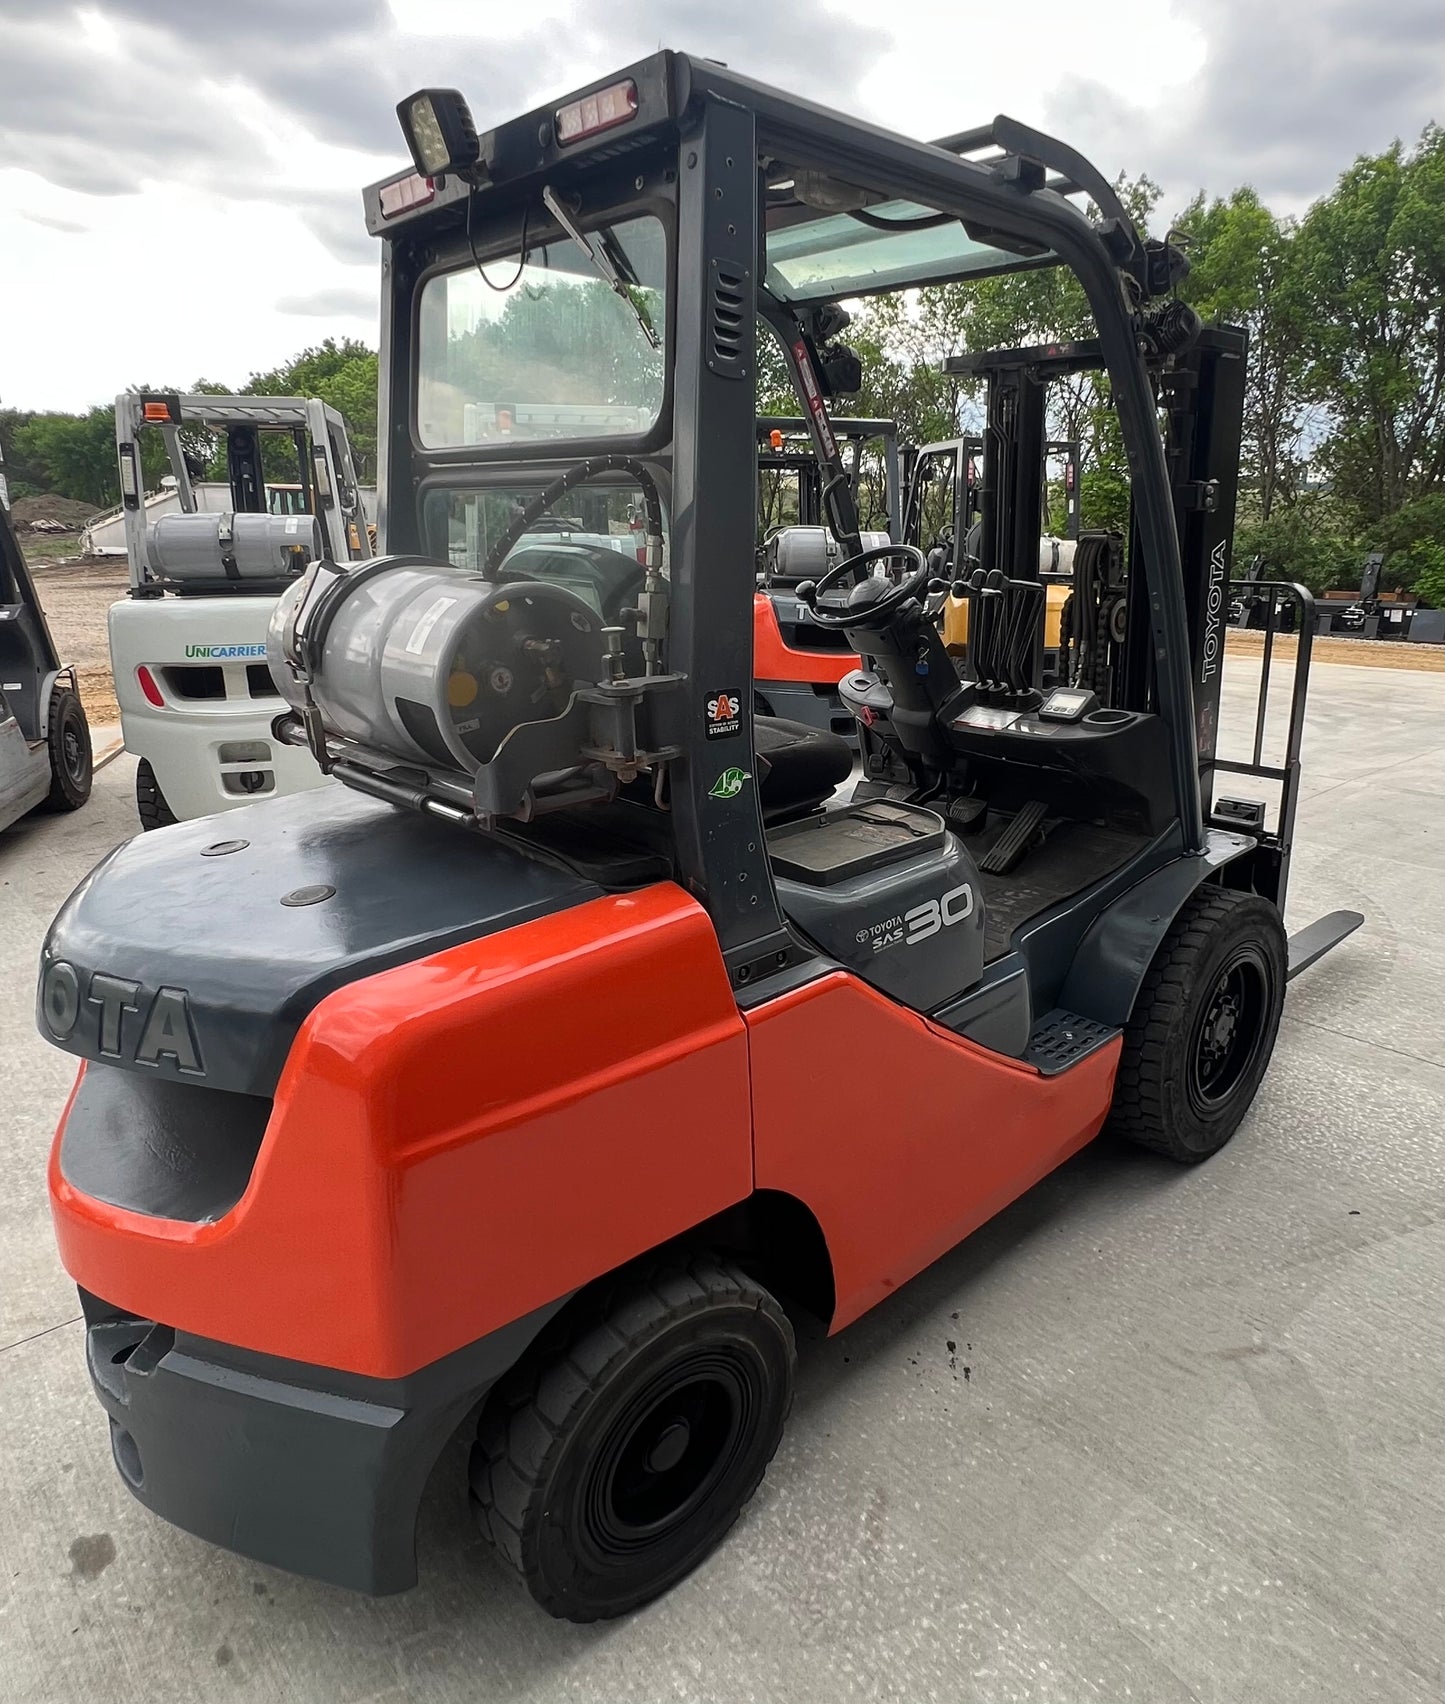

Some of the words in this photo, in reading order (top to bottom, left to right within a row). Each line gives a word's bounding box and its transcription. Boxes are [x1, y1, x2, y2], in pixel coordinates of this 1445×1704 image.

[1201, 539, 1227, 684] TOYOTA
[707, 694, 740, 721] SAS
[709, 723, 739, 735] STABILITY
[869, 915, 903, 937] TOYOTA
[904, 883, 974, 945] 30
[872, 927, 904, 950] SAS
